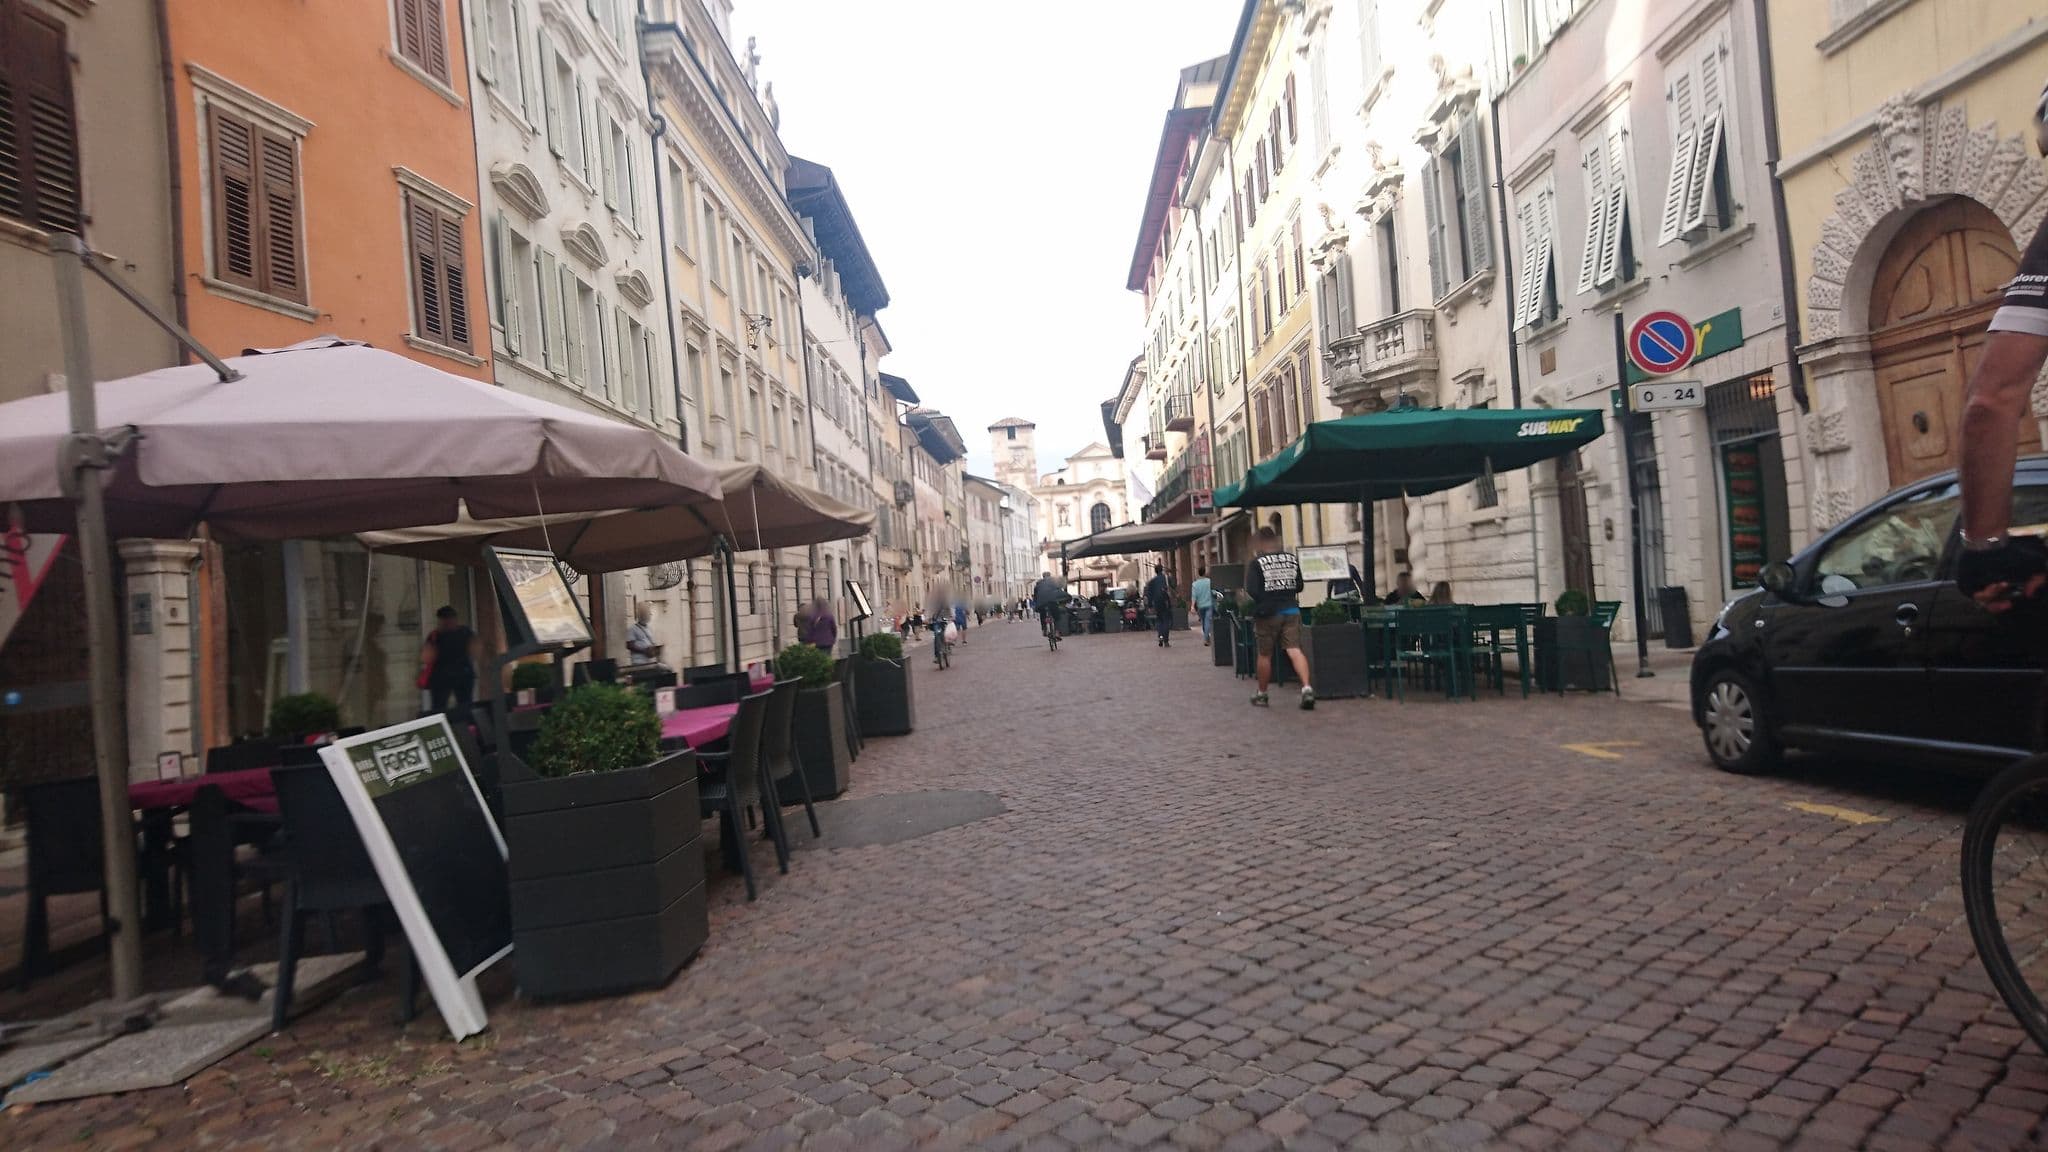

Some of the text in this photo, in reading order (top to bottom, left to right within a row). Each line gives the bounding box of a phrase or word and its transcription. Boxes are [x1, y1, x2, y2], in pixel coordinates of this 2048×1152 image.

[1674, 388, 1695, 401] 24
[1517, 418, 1584, 437] SUBWAY
[1257, 553, 1298, 565] DIESEL
